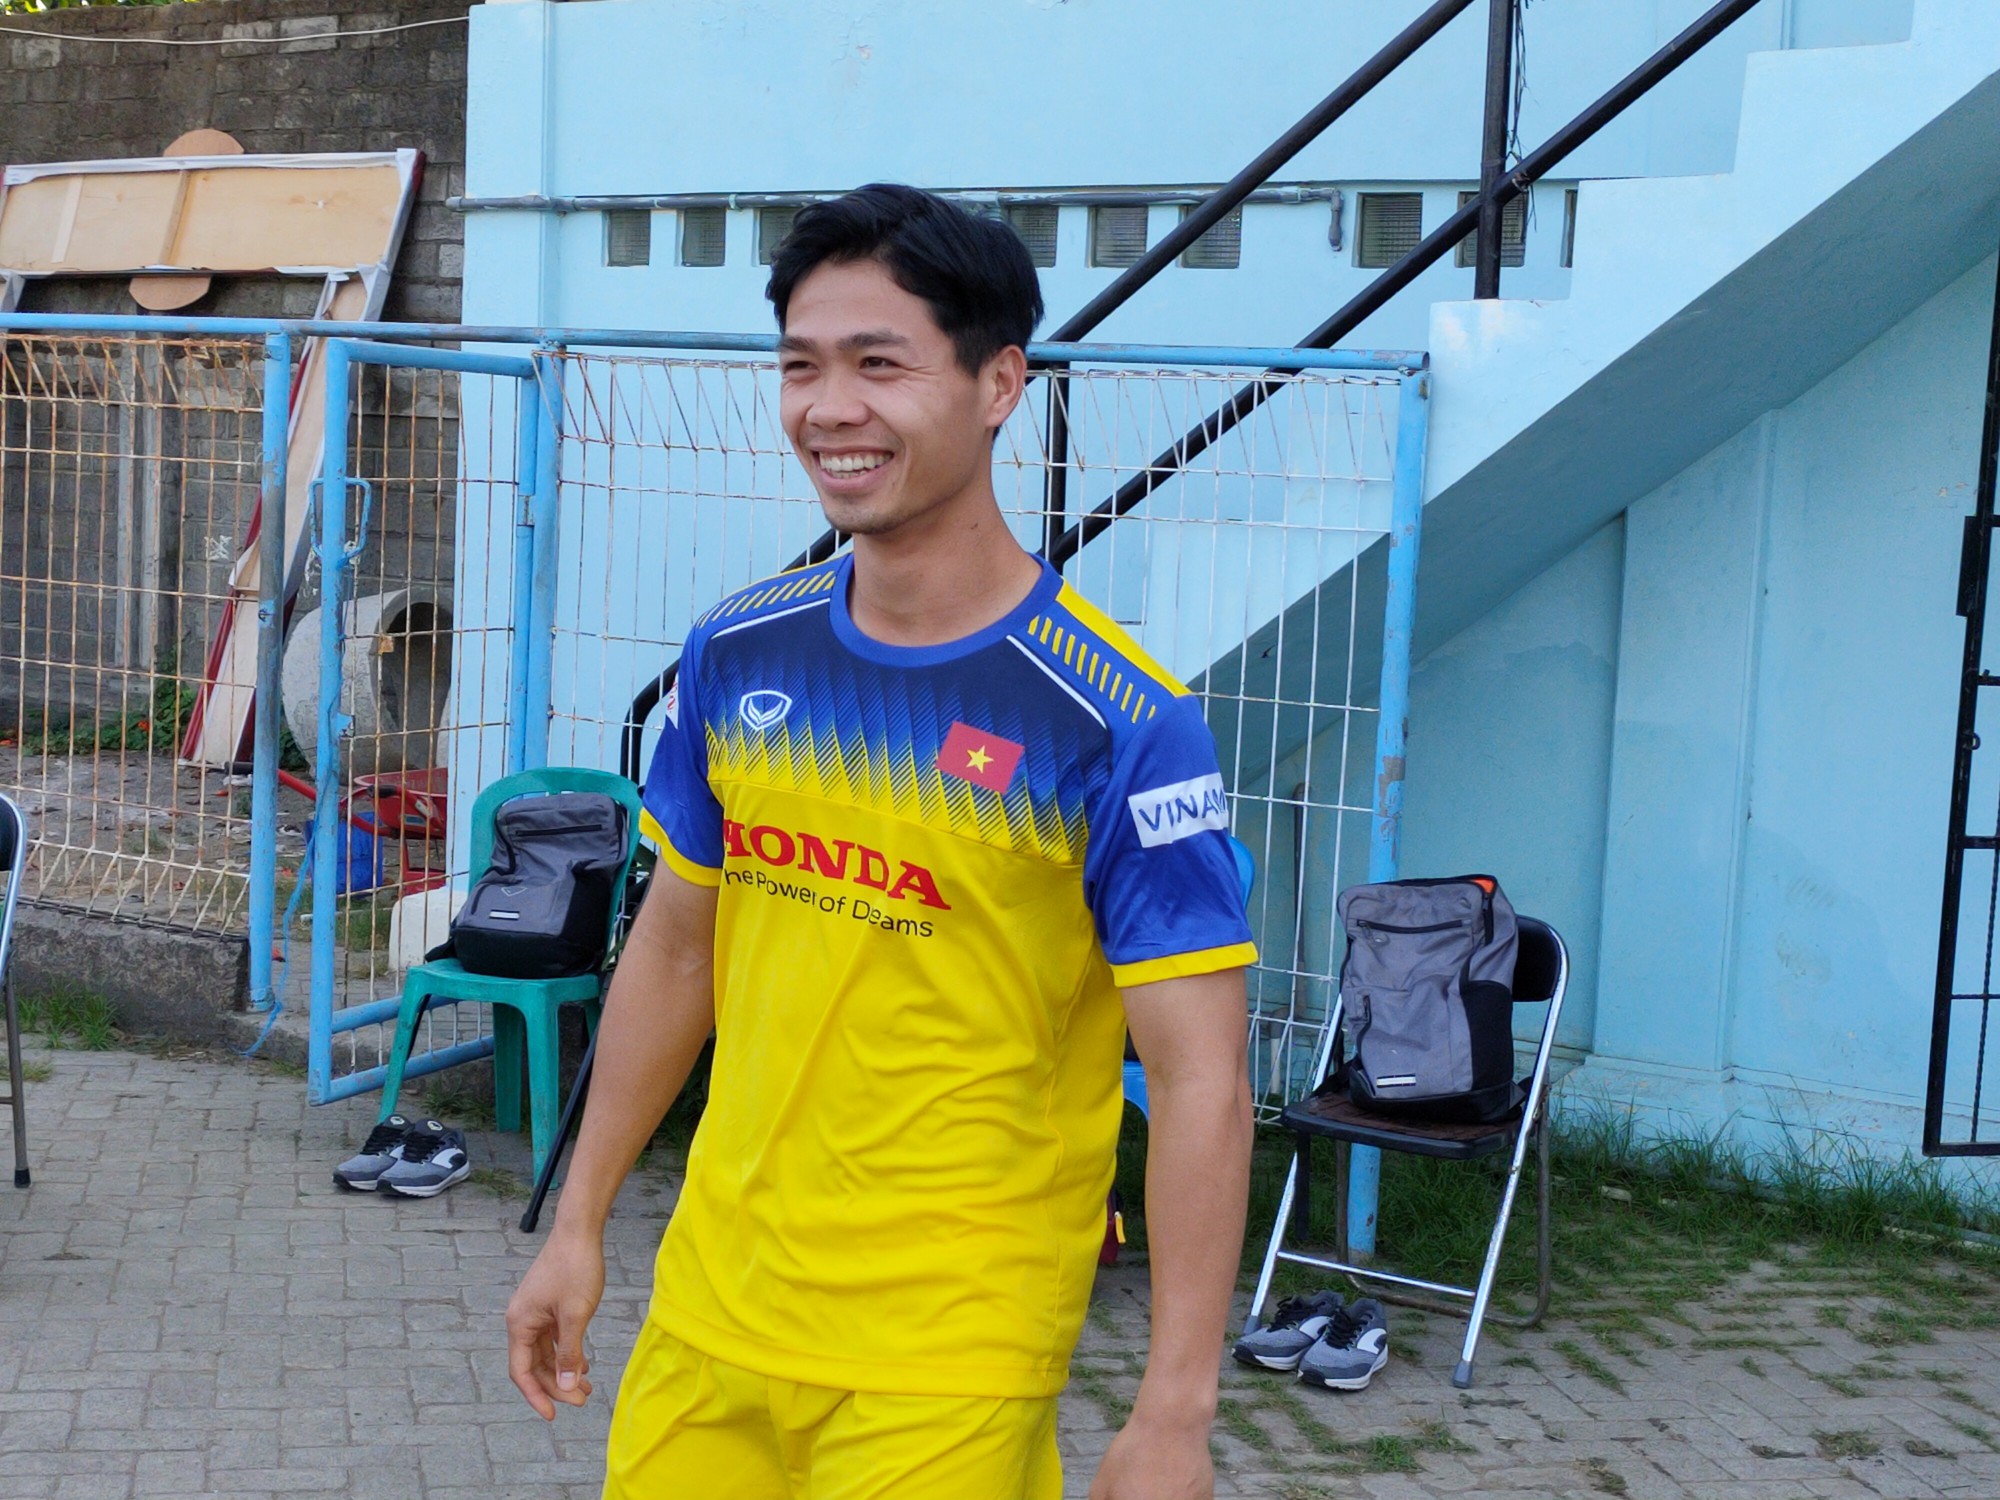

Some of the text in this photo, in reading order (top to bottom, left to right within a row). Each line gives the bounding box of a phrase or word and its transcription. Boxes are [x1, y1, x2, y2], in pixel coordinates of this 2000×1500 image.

[723, 819, 951, 910] HONDA
[724, 868, 934, 937] he Power of Deams
